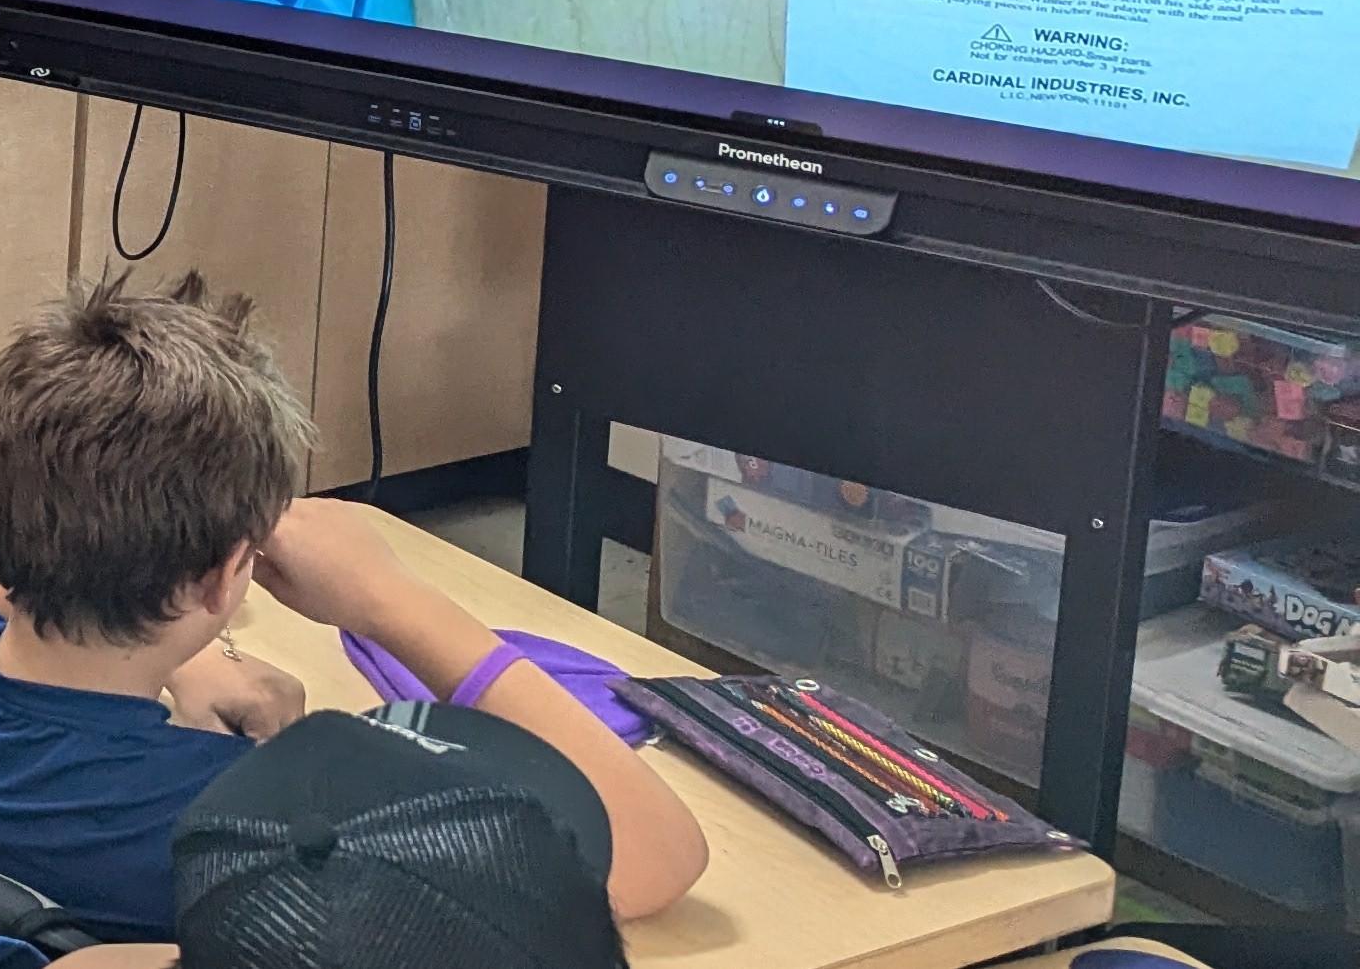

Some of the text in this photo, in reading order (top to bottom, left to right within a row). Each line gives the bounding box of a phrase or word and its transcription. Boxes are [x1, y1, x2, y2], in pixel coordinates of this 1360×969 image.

[970, 40, 1028, 54] CHOKING
[1034, 28, 1128, 51] WARNING:
[970, 51, 989, 59] Not
[1012, 54, 1057, 65] children
[1062, 58, 1094, 67] under
[1099, 62, 1106, 70] 3
[932, 68, 1190, 107] CARDINAL INDUSTRIES, INC.
[718, 142, 823, 175] Promethean
[747, 517, 858, 568] MAGNA-TILES
